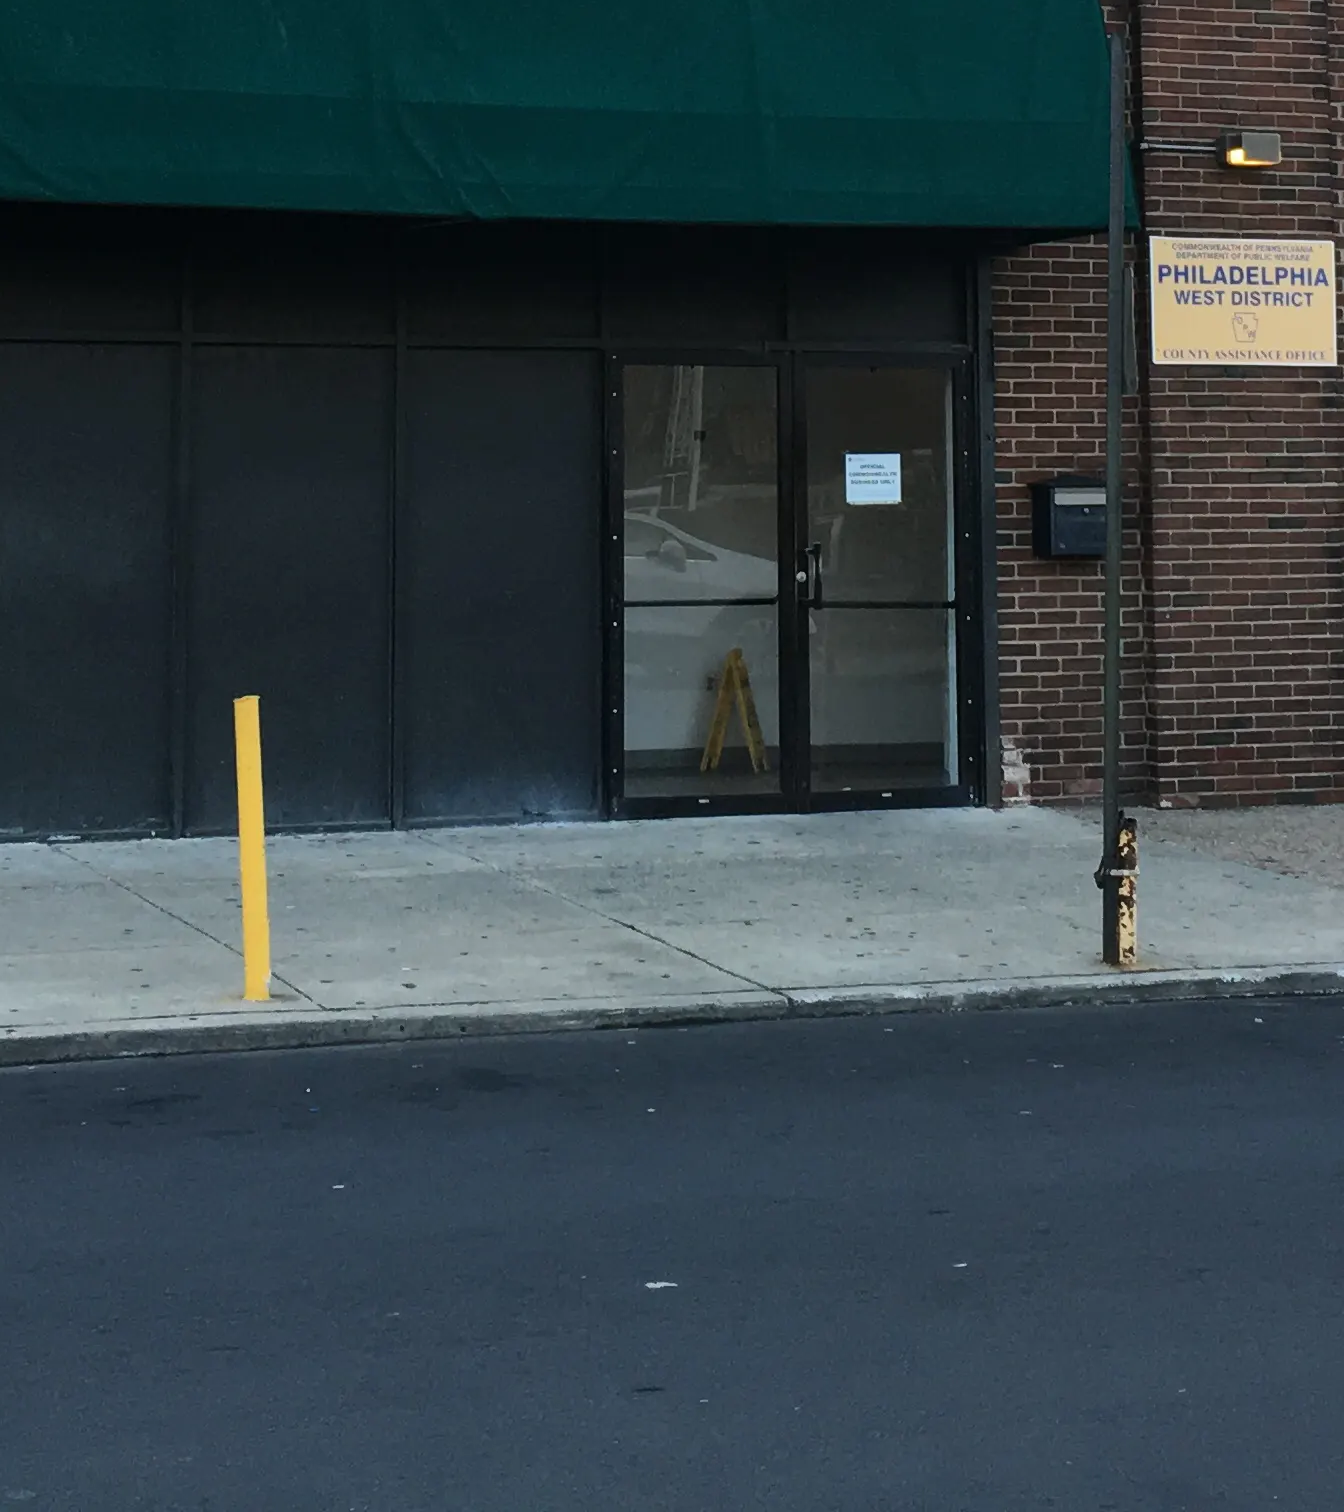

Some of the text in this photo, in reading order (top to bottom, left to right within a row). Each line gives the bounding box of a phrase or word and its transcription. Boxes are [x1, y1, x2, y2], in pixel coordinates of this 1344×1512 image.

[1243, 244, 1253, 252] OF
[1231, 252, 1241, 260] OF
[1158, 264, 1329, 287] PHILADELPHIA
[1174, 290, 1314, 307] WEST DISTRICT
[1163, 349, 1326, 360] COUNTY ASSISTANCE OFFICE
